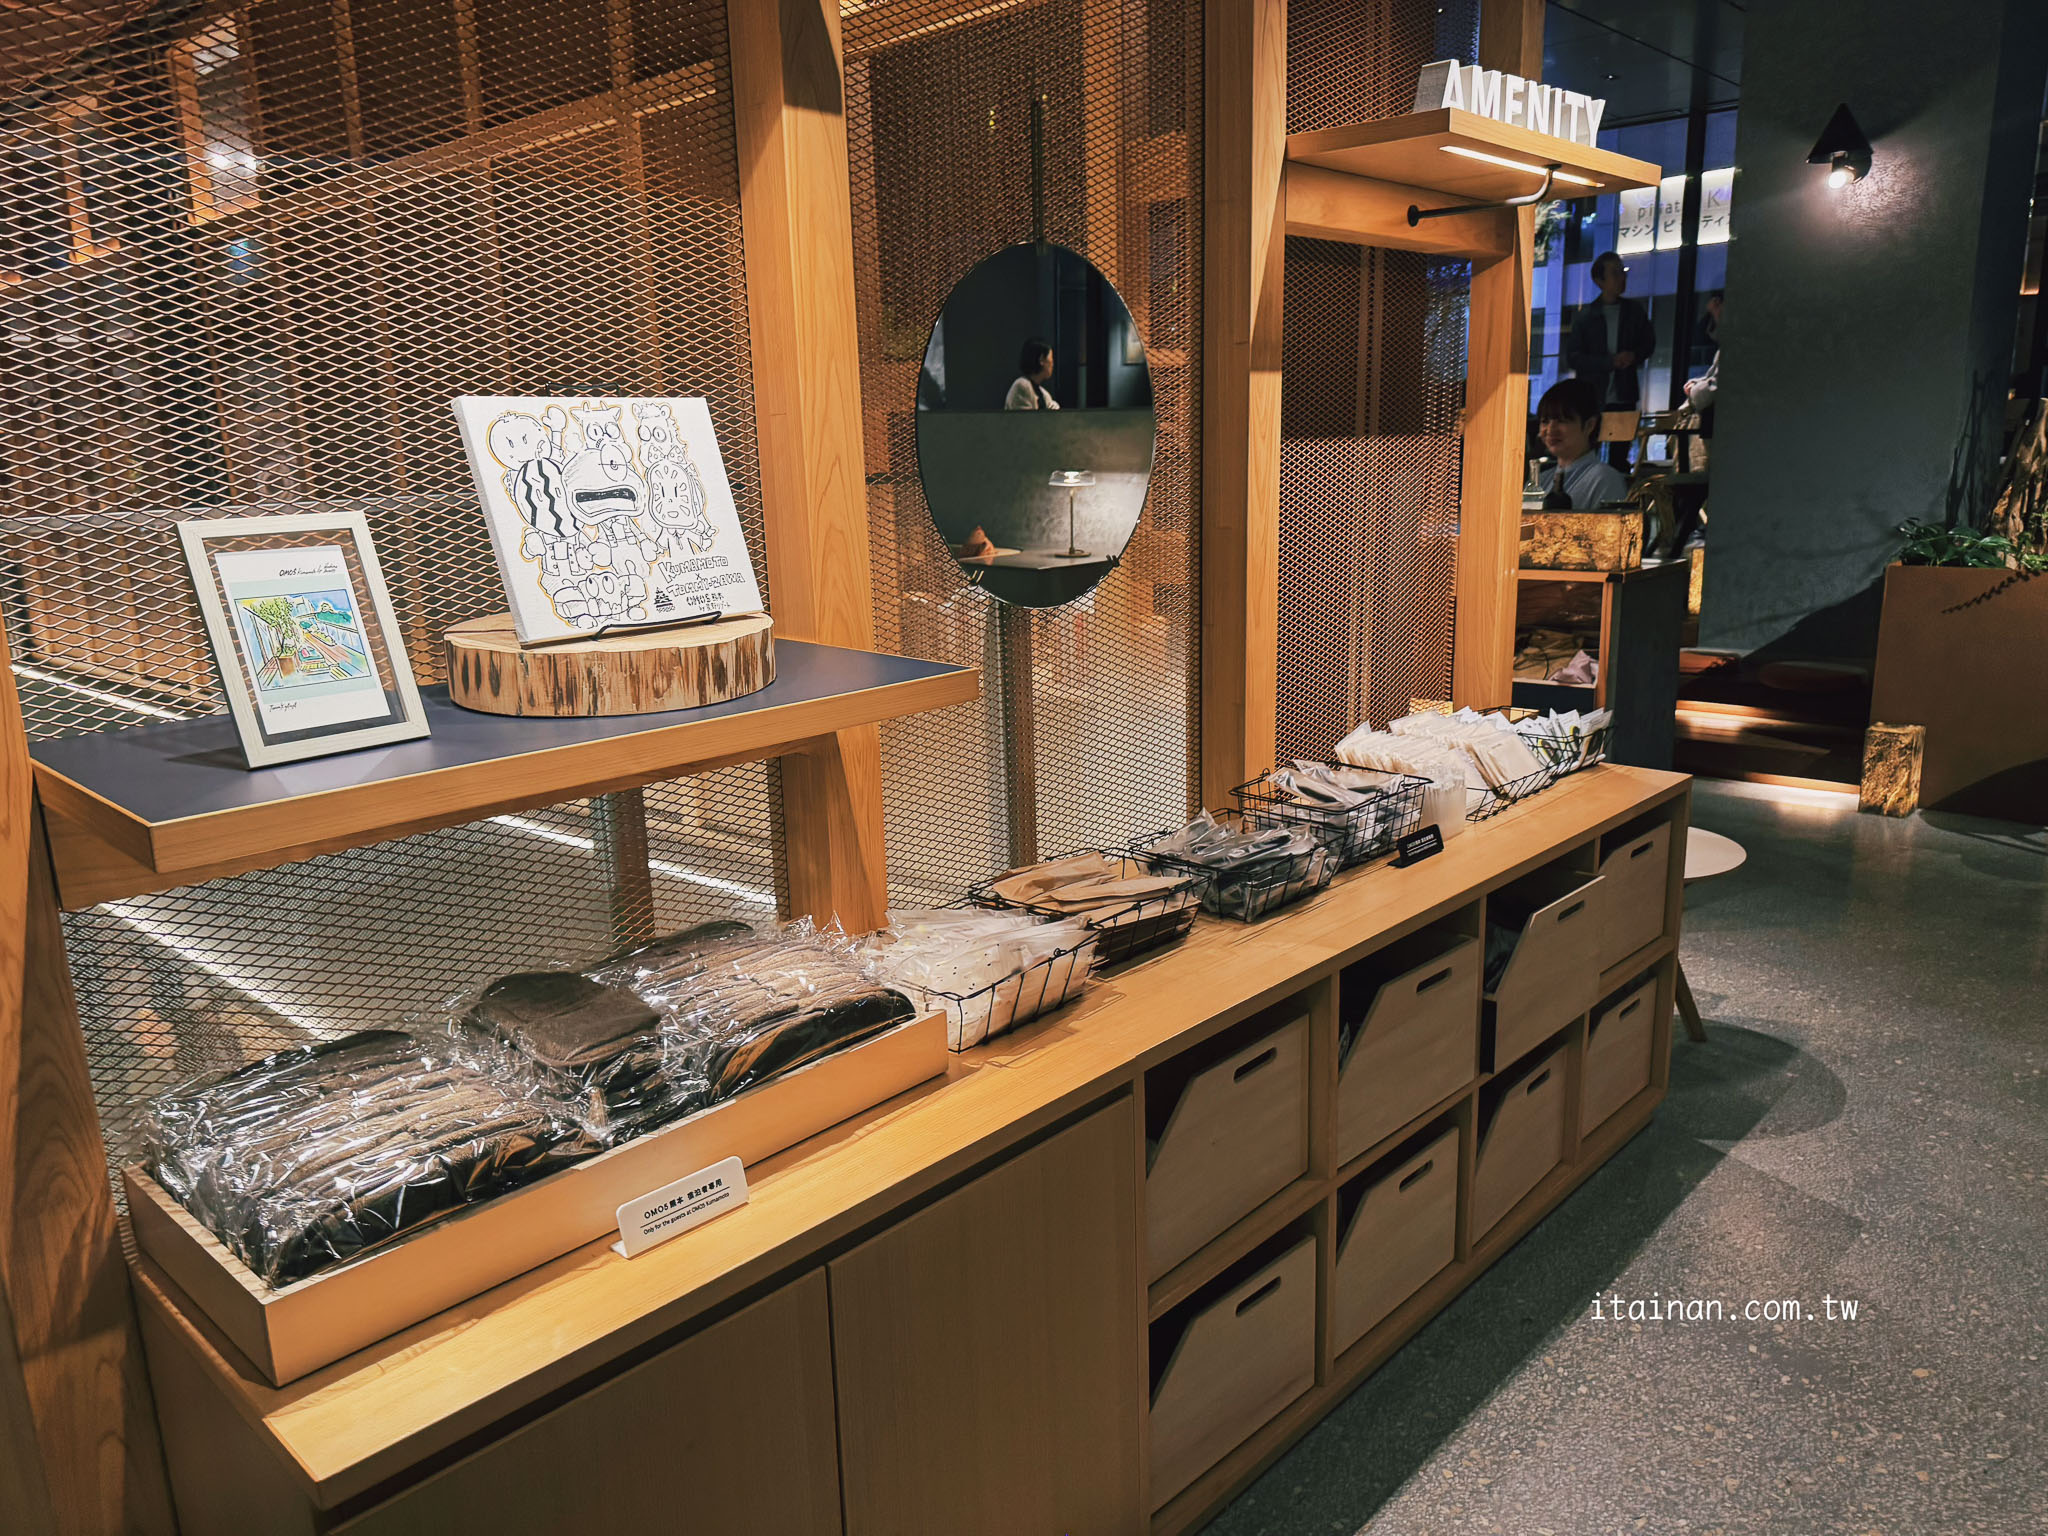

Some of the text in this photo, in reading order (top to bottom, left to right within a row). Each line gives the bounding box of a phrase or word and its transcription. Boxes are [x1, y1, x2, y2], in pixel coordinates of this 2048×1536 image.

[1441, 58, 1606, 148] AMENITY
[657, 556, 729, 584] KUMAMOTO
[665, 572, 746, 598] TOMMY-ZAWA
[643, 1227, 655, 1235] Only
[662, 1219, 671, 1227] the
[671, 1213, 686, 1223] guests
[691, 1202, 706, 1213] OMO5
